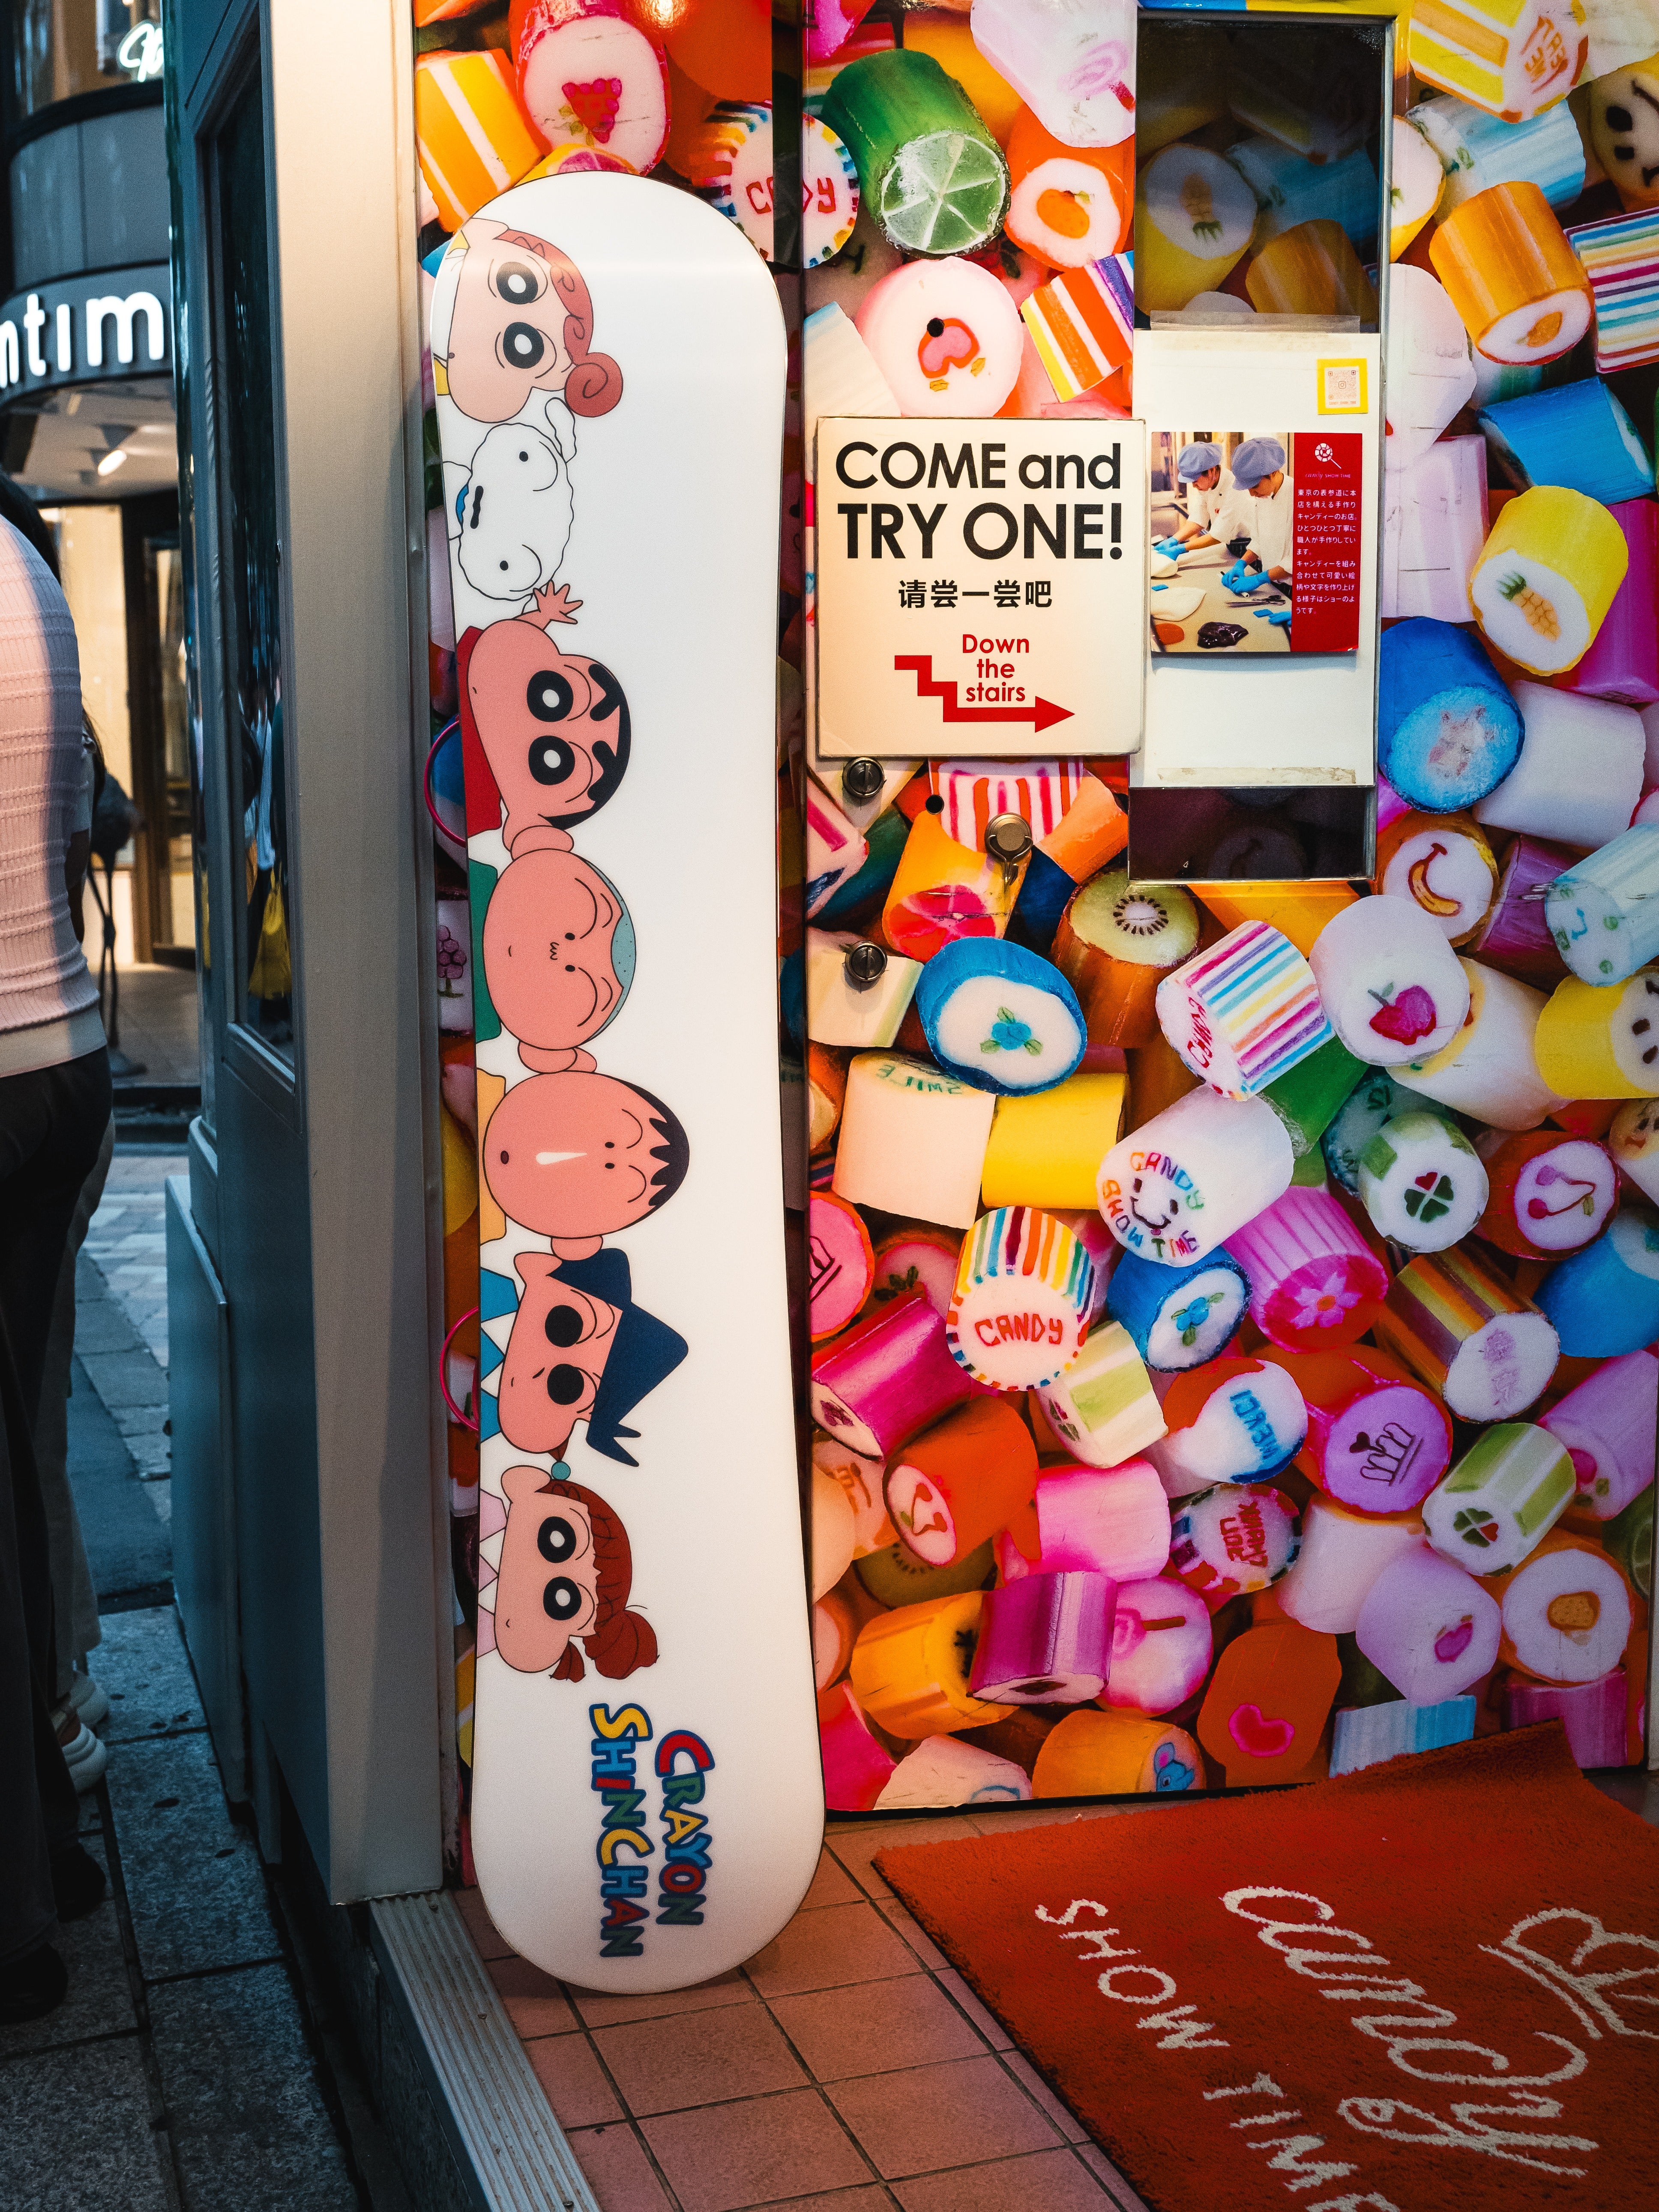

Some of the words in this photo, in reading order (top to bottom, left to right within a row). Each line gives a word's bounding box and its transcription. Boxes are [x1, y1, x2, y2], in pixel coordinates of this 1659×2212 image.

[835, 441, 1006, 489] COME
[1018, 443, 1121, 490] and
[1305, 471, 1323, 480] candy
[838, 503, 948, 559] TRY
[963, 502, 1123, 560] ONE!
[898, 579, 1052, 609] 请尝一尝吧
[962, 634, 1029, 653] Down
[966, 682, 1026, 702] stairs
[976, 659, 1015, 679] the
[1129, 1152, 1205, 1210] CANDY
[1102, 1179, 1144, 1248] SHOW
[1151, 1230, 1200, 1258] TIME
[975, 1312, 1063, 1347] CANDY
[589, 1703, 655, 1957] SHINCHAN
[654, 1729, 715, 1925] CRAYON
[1035, 1899, 1231, 2051] SHOW
